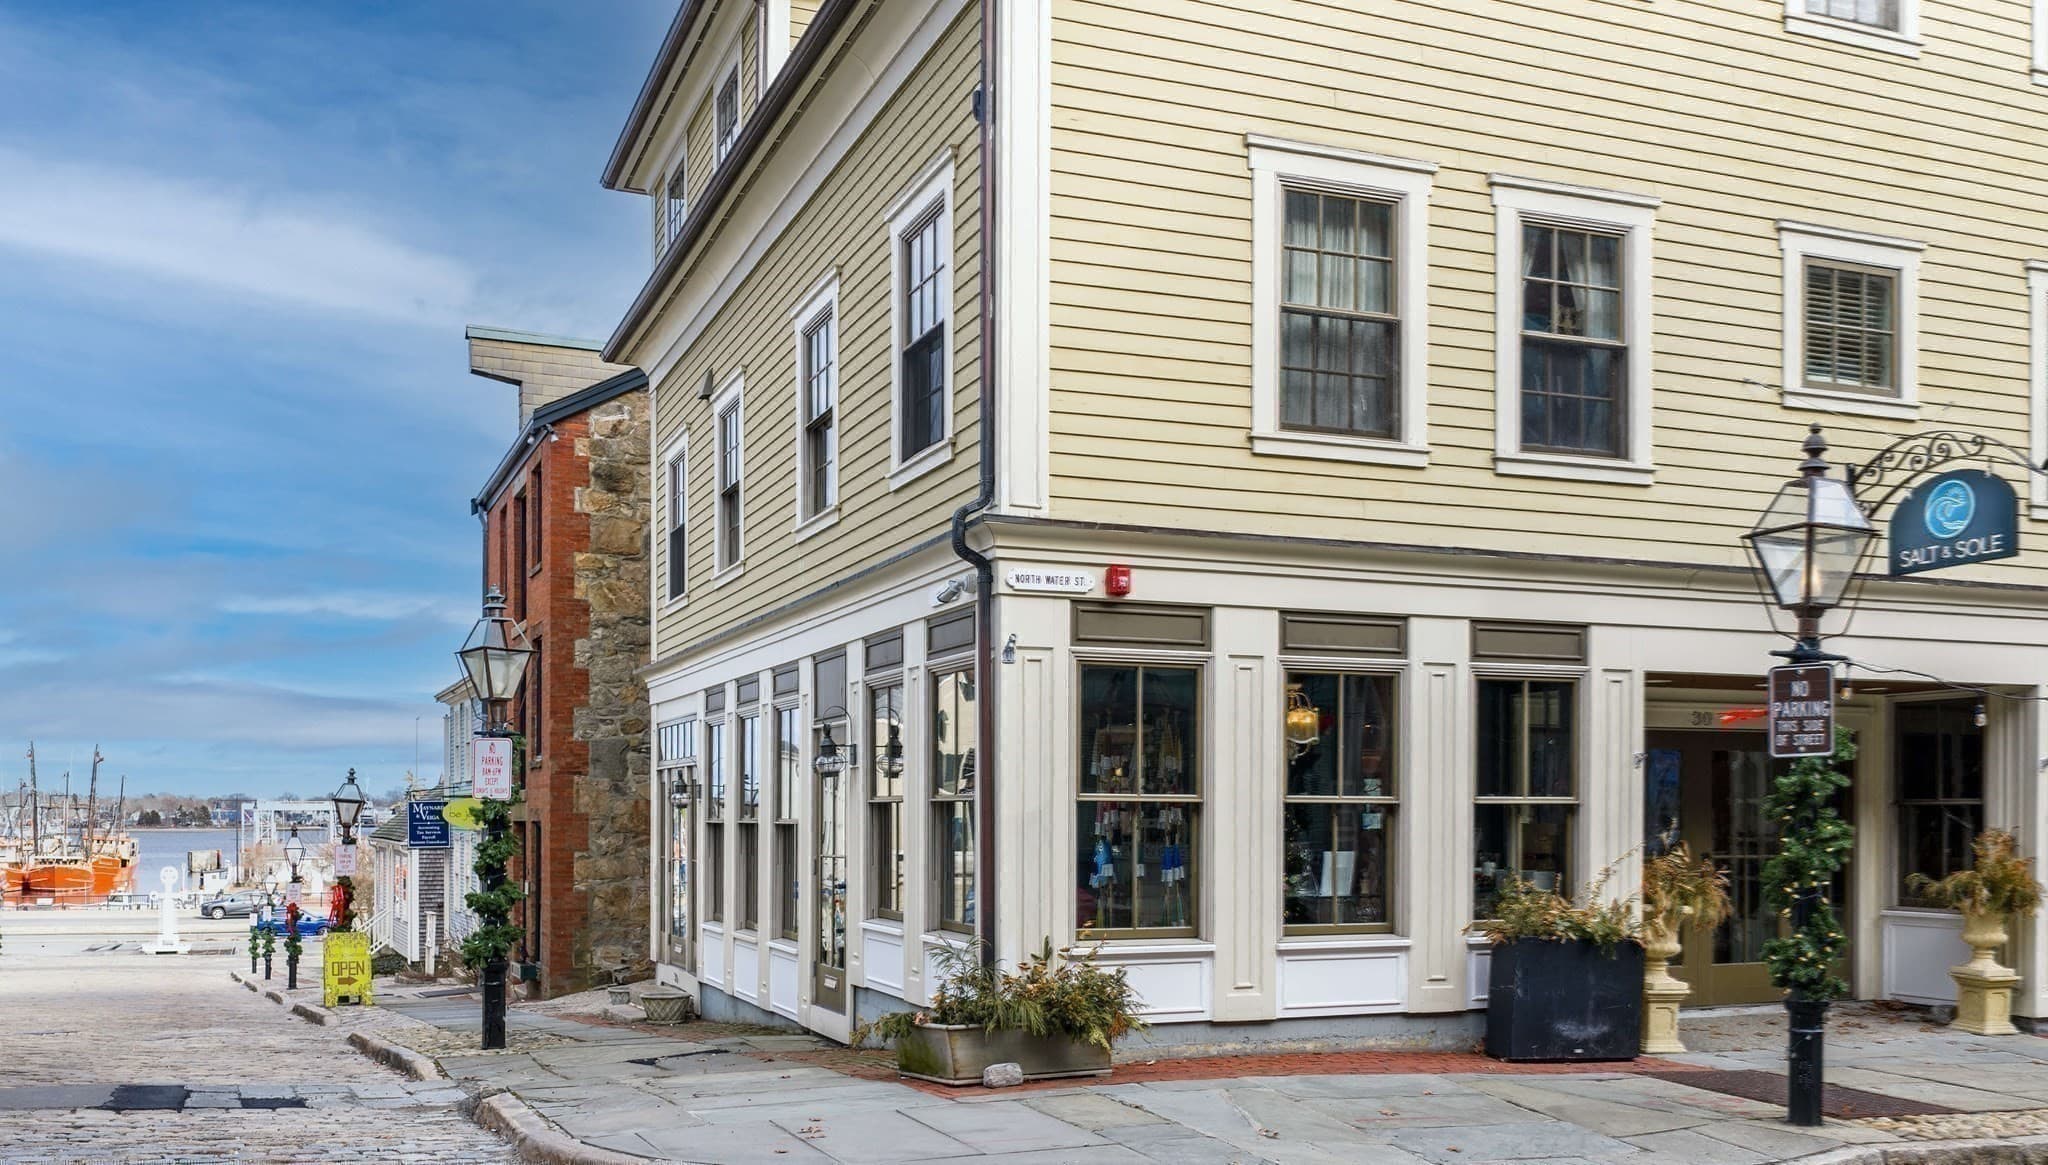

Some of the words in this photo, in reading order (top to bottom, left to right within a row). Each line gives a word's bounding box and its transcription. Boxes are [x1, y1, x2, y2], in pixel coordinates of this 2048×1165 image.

[1900, 545, 1940, 568] SALT
[1941, 546, 1952, 558] &
[1955, 534, 2004, 558] SOLE
[1014, 574, 1041, 585] NORTH
[1044, 575, 1070, 586] WATER
[1791, 681, 1809, 697] NO
[1771, 701, 1830, 717] PARKING
[1776, 720, 1798, 732] THIS
[1802, 719, 1824, 732] SIDE
[1776, 734, 1790, 746] OF
[1793, 733, 1825, 746] STREET
[481, 756, 503, 766] PARKING
[331, 961, 365, 976] OPEN
